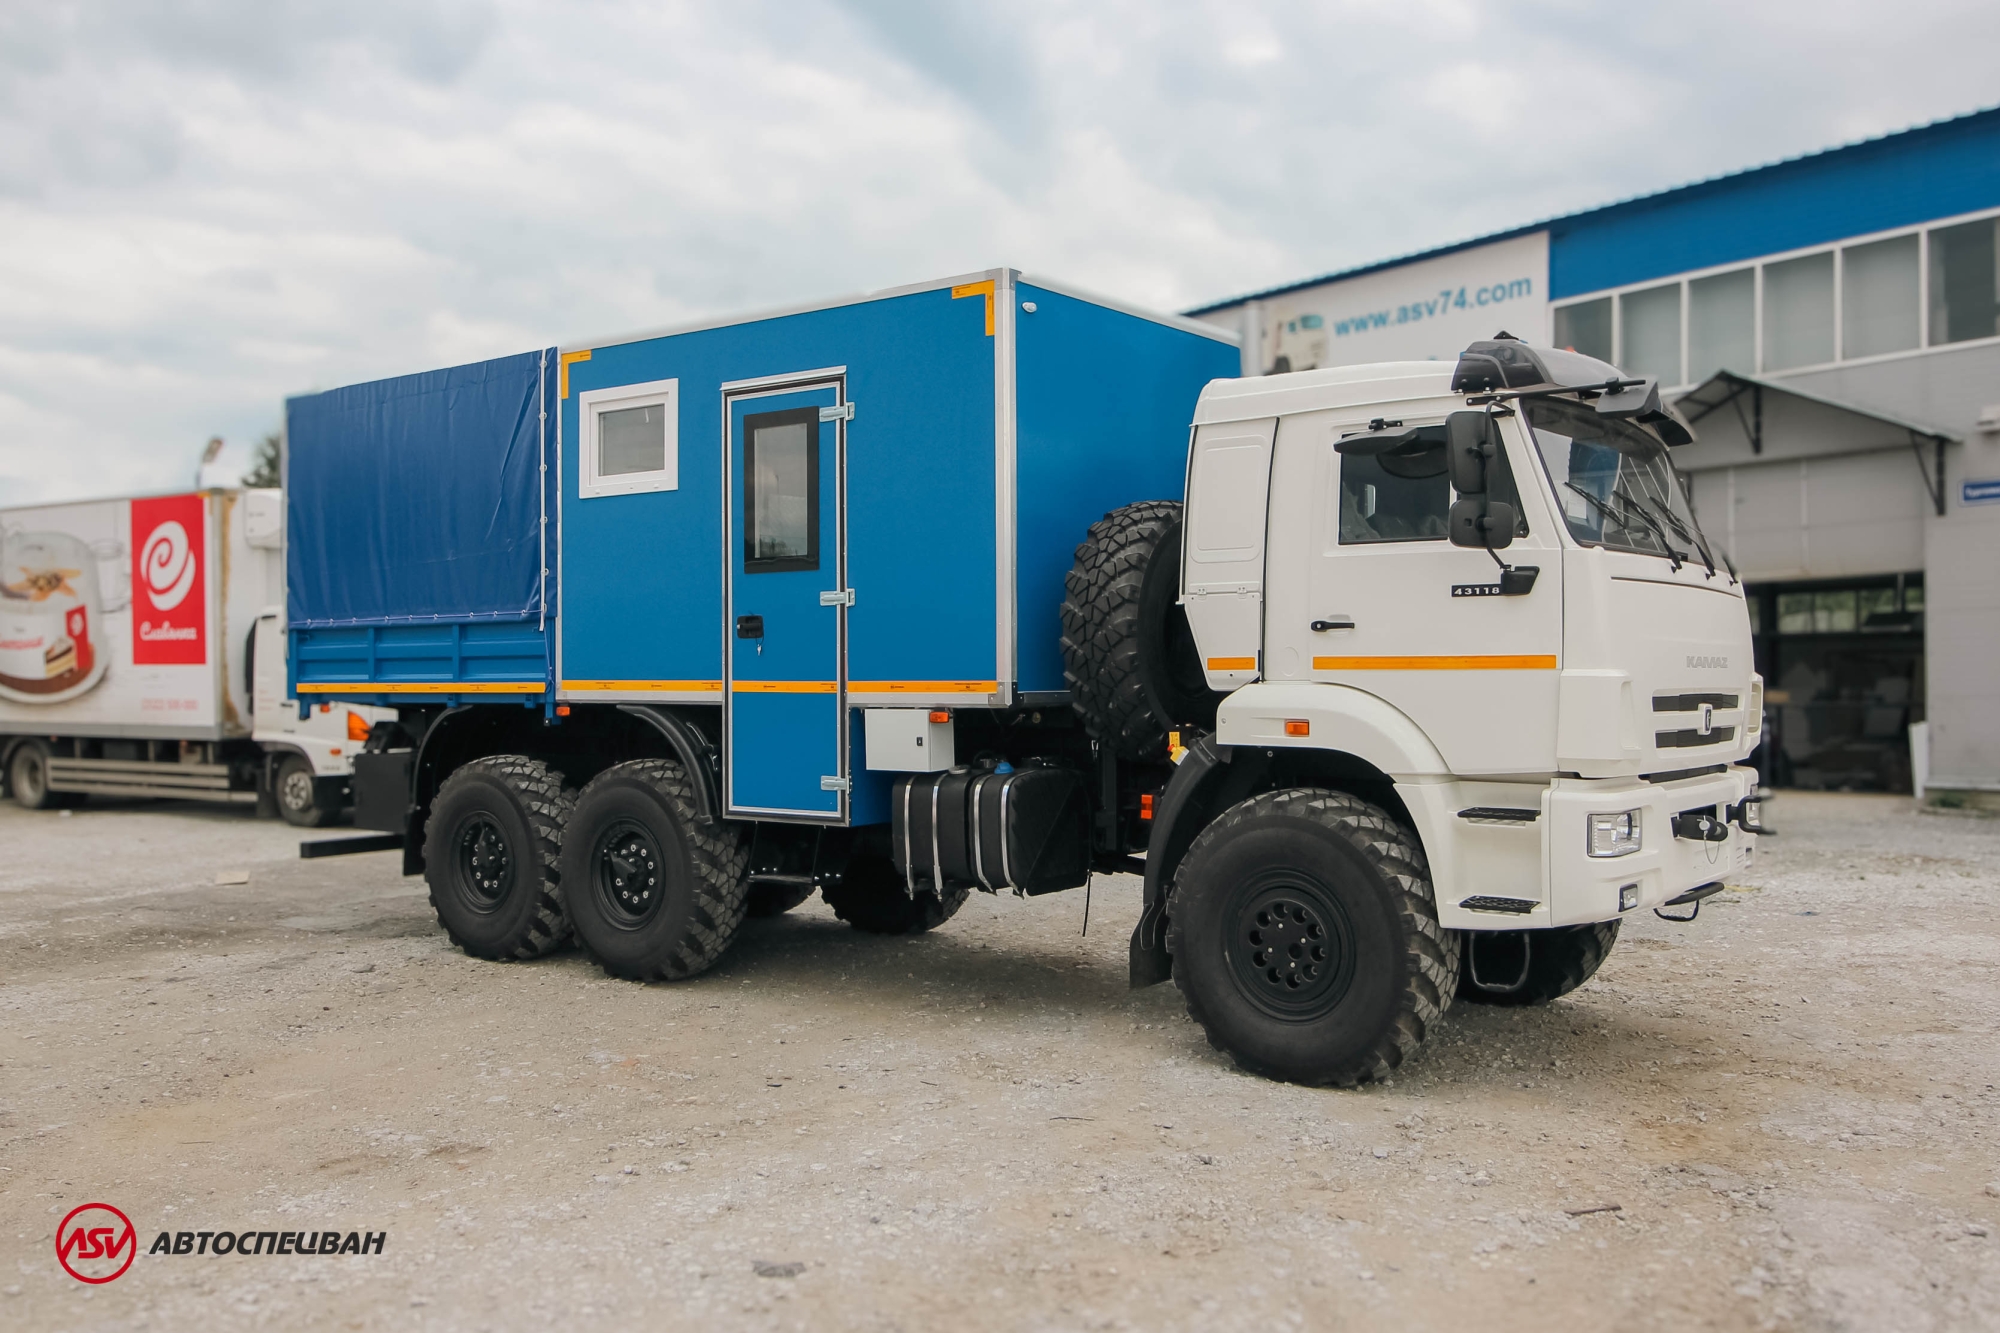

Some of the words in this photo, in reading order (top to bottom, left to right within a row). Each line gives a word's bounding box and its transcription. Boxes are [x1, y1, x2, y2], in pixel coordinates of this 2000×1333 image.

[1334, 276, 1533, 336] www.asv74.com
[1453, 587, 1500, 595] 43118
[1686, 655, 1729, 669] KAMAZ
